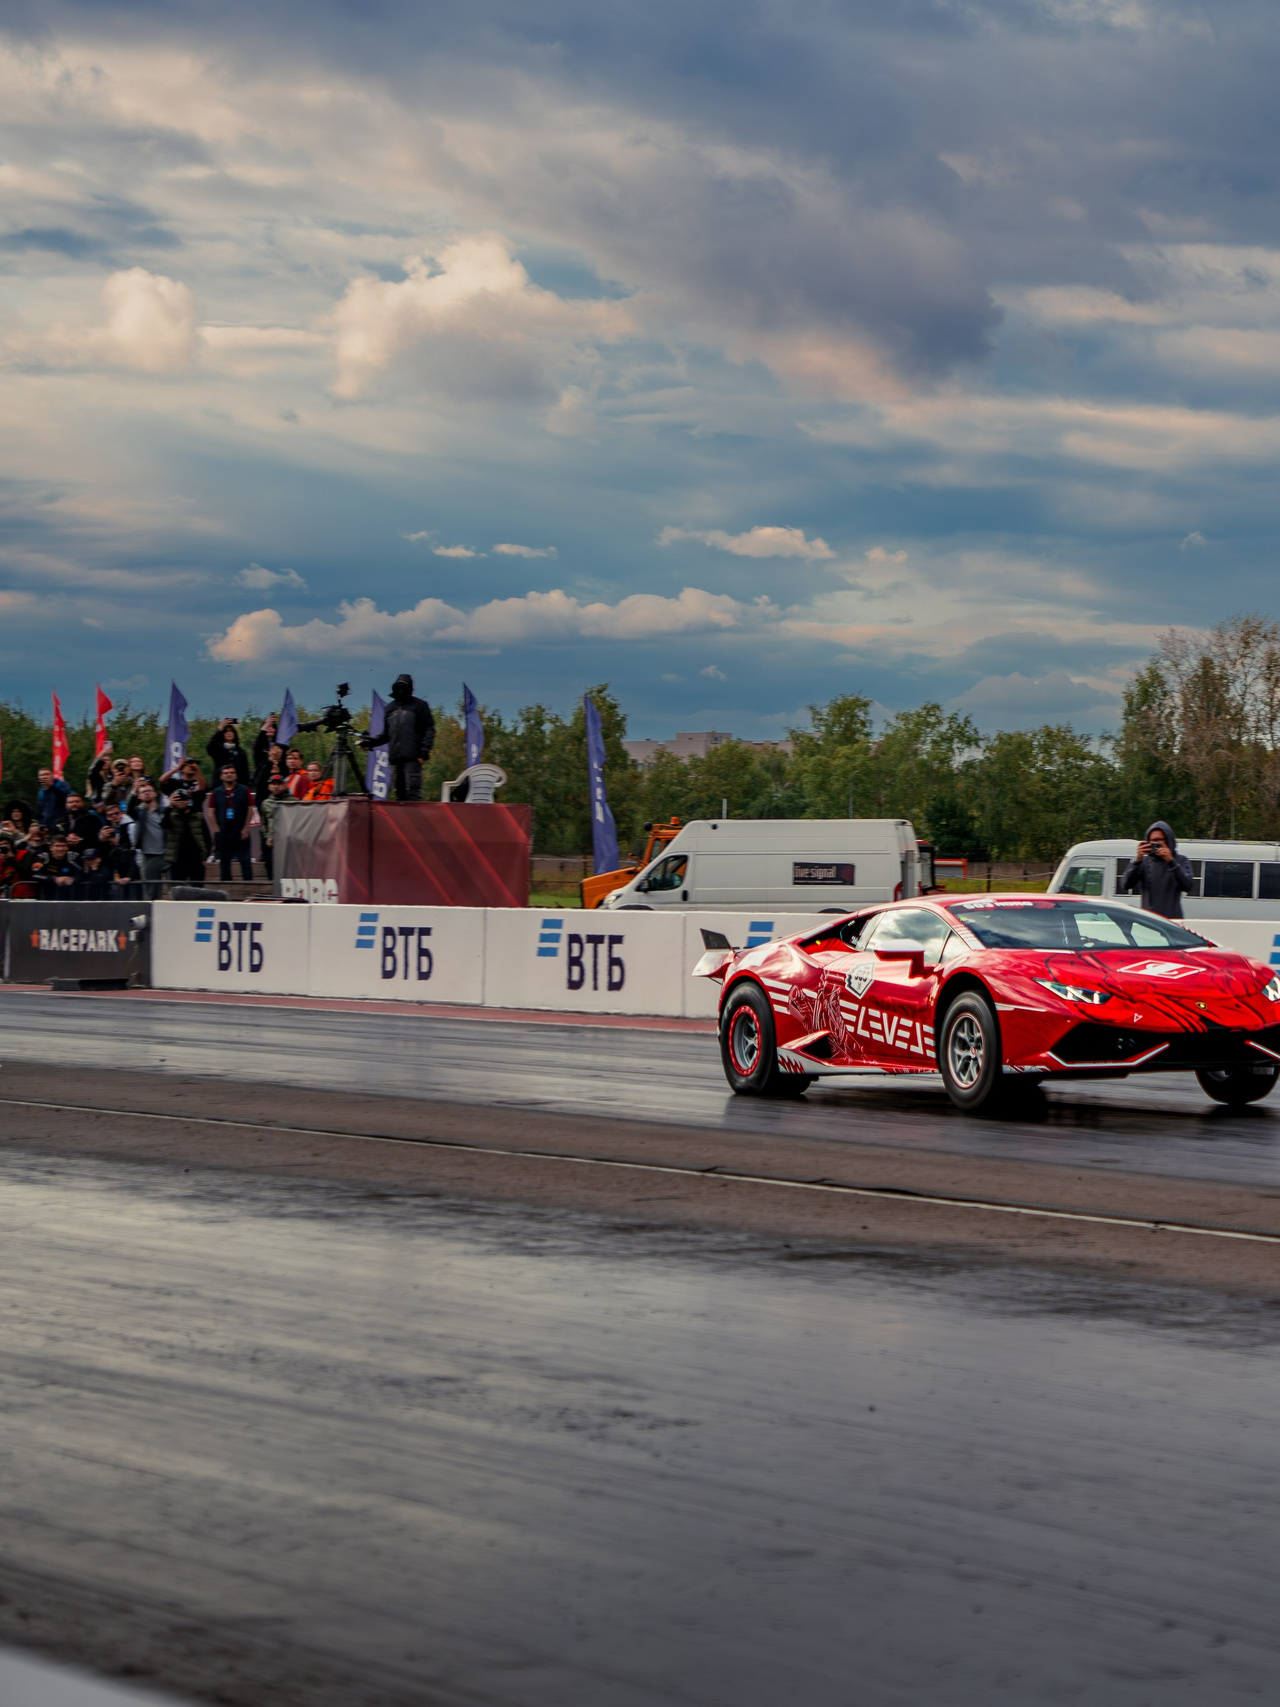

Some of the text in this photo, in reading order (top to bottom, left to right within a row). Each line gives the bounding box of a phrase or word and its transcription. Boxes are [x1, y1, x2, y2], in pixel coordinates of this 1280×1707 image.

[811, 866, 836, 879] signal
[39, 928, 119, 952] RACEPARK
[218, 922, 264, 973] ВТБ
[381, 926, 433, 981] ВТБ
[567, 933, 625, 991] ВТБ
